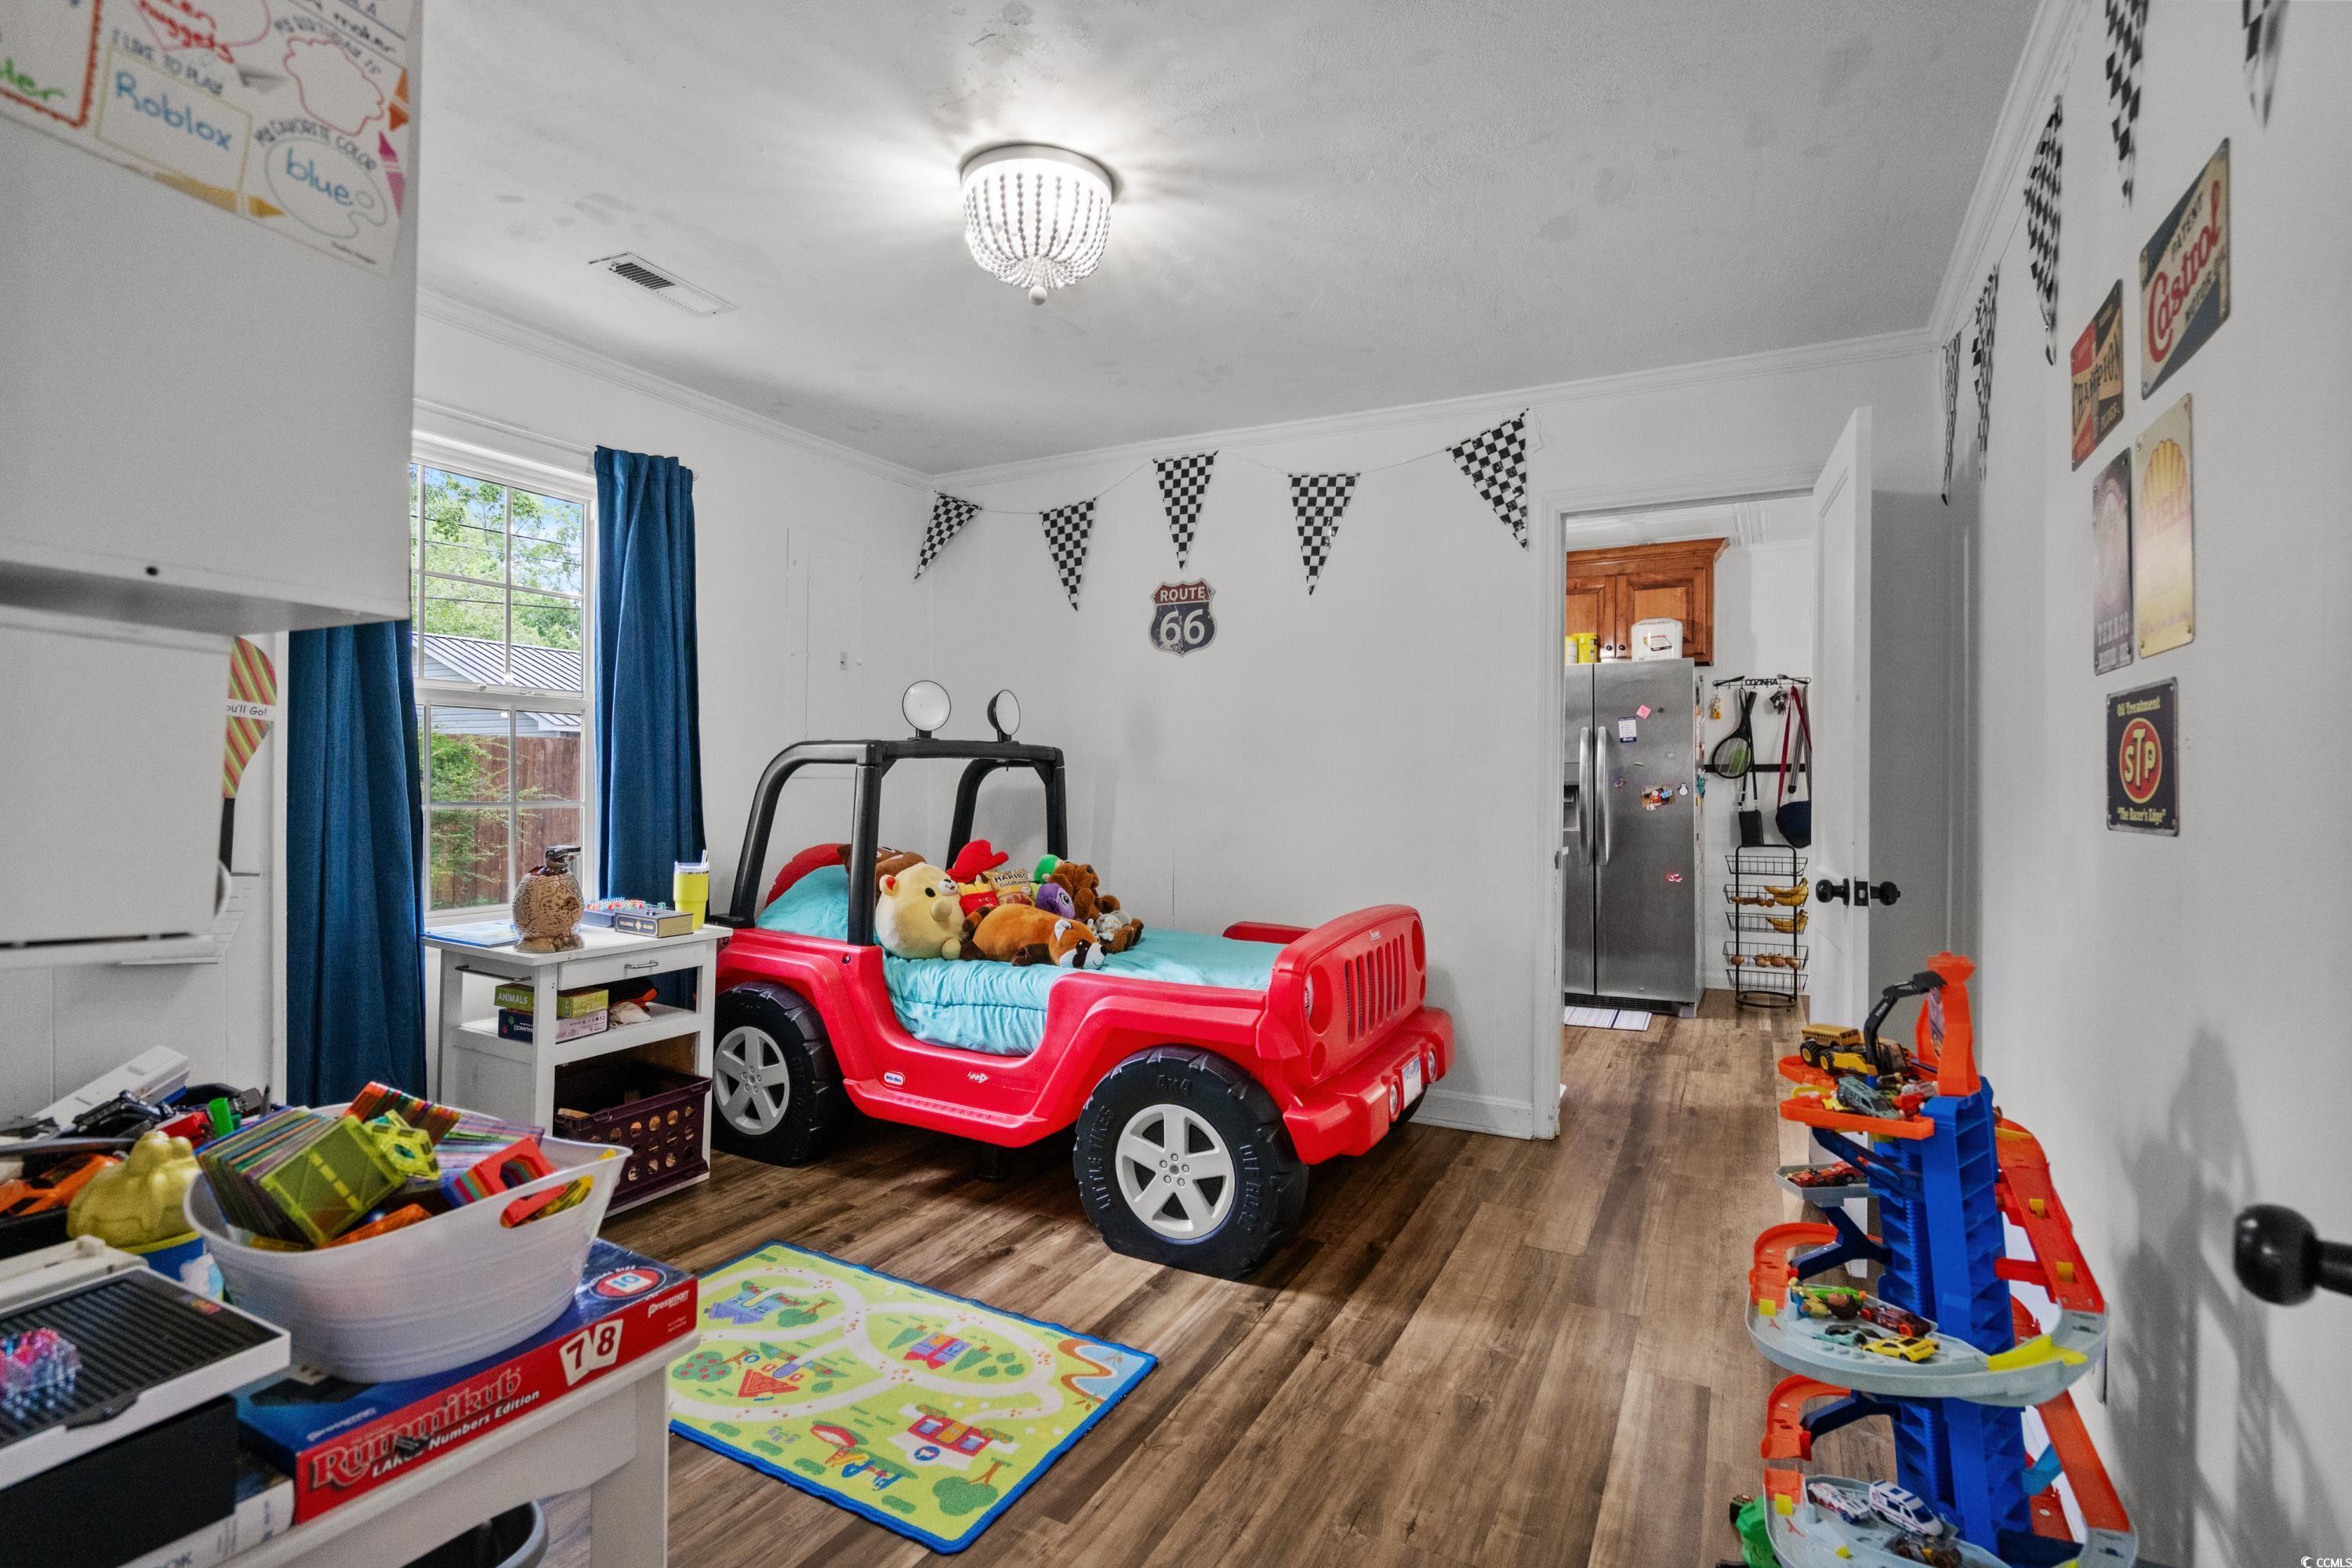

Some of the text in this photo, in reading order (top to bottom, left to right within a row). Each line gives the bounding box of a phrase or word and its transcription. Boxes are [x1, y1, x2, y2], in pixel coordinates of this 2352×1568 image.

[115, 71, 231, 152] Roblox
[335, 136, 376, 171] COLOR
[285, 146, 354, 206] blue
[2148, 180, 2220, 363] Castrol
[1160, 586, 1206, 602] ROUTE
[1160, 608, 1205, 644] 66
[249, 706, 267, 717] Go!
[2126, 696, 2161, 715] Treatment
[2125, 728, 2156, 787] STP
[994, 873, 1029, 883] HARIBO
[497, 993, 528, 1004] ANIMALS
[612, 1275, 641, 1288] 10
[566, 1326, 615, 1370] 7 8
[314, 1367, 521, 1489] Rummikub
[429, 1414, 490, 1450] Numbers
[494, 1390, 540, 1418] Edition
